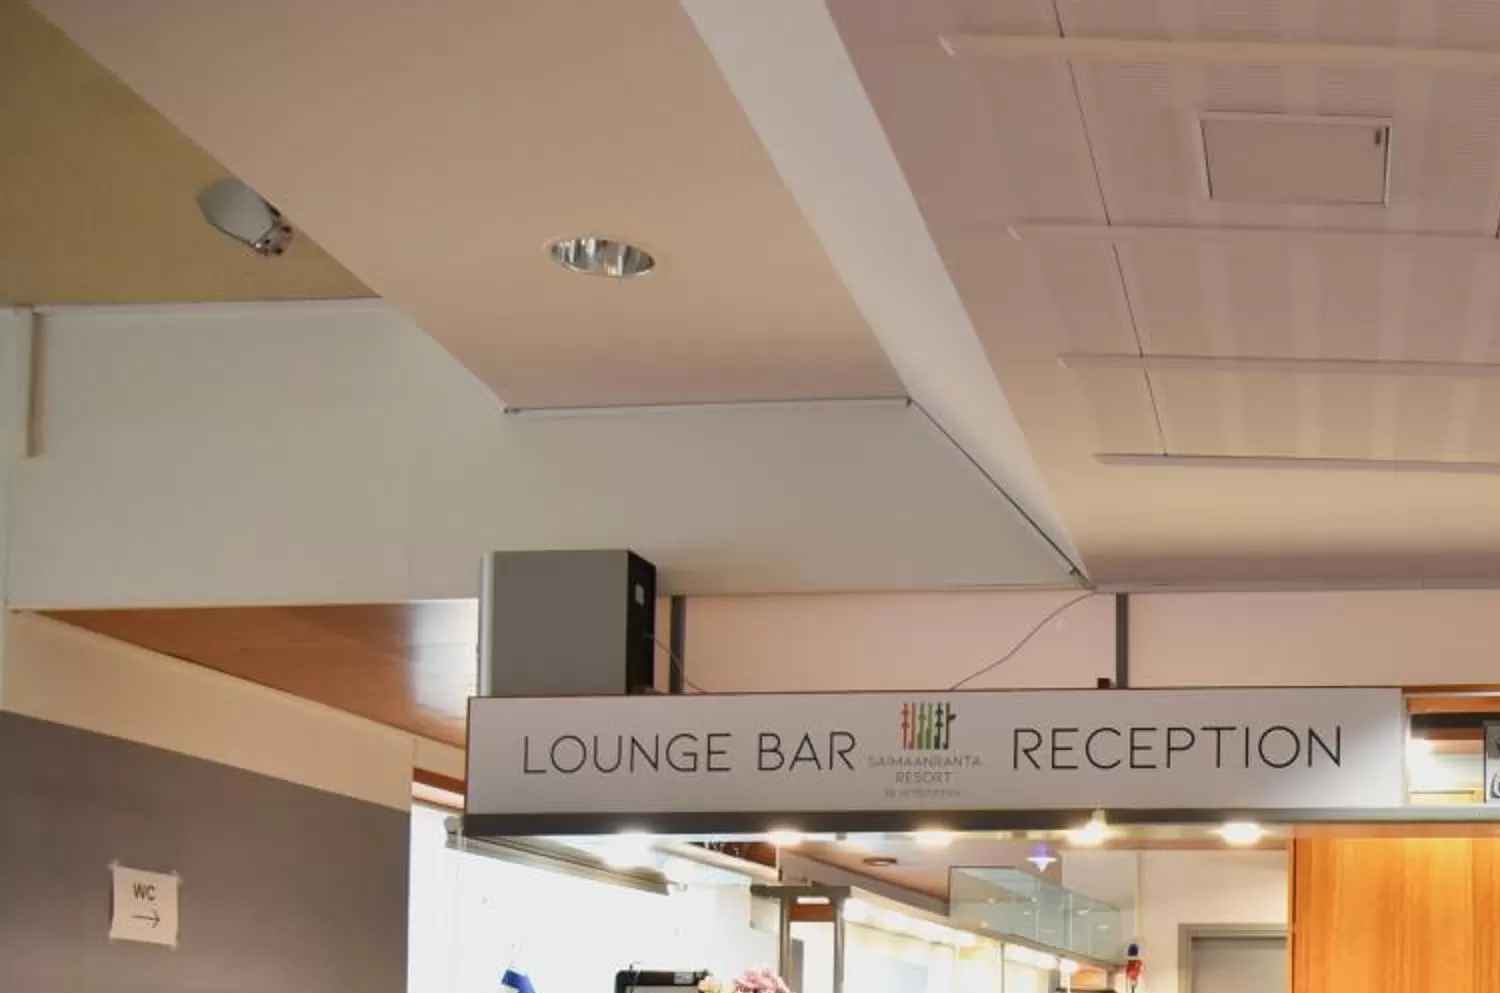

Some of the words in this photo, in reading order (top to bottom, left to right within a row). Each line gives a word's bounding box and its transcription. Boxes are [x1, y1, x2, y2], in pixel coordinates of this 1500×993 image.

[523, 733, 733, 775] LOUNGE
[757, 731, 857, 772] BAR
[1012, 725, 1342, 770] RECEPTION
[867, 754, 983, 769] SAIMAANRANTA
[895, 771, 952, 784] RESORT
[132, 883, 156, 902] WC
